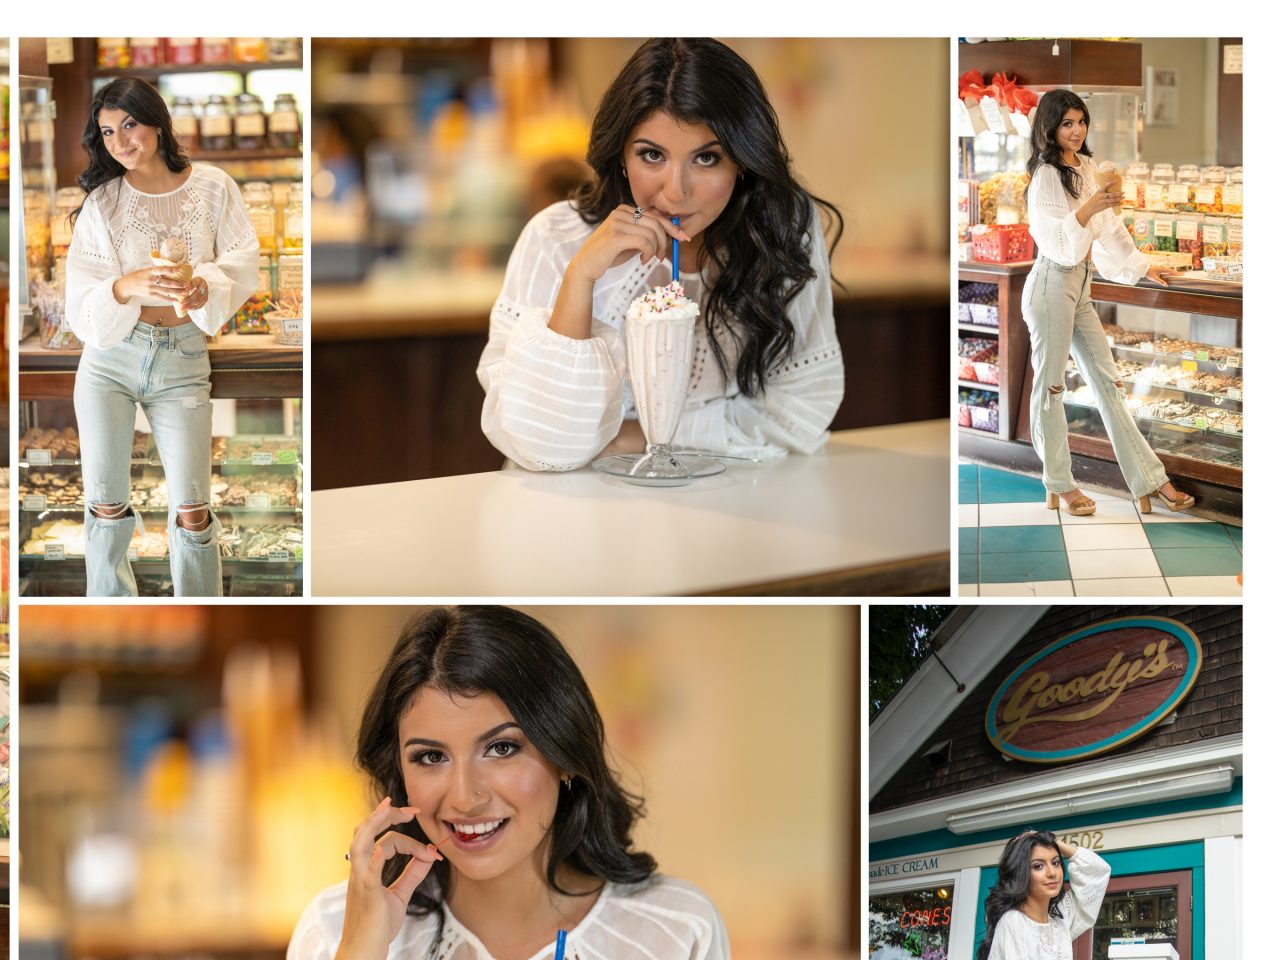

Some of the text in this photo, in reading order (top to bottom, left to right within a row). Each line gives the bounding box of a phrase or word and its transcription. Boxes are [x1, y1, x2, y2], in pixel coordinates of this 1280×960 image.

[993, 638, 1172, 742] Goody's
[1062, 831, 1104, 849] 1502
[902, 857, 939, 873] CREAM
[900, 906, 951, 928] CONES
